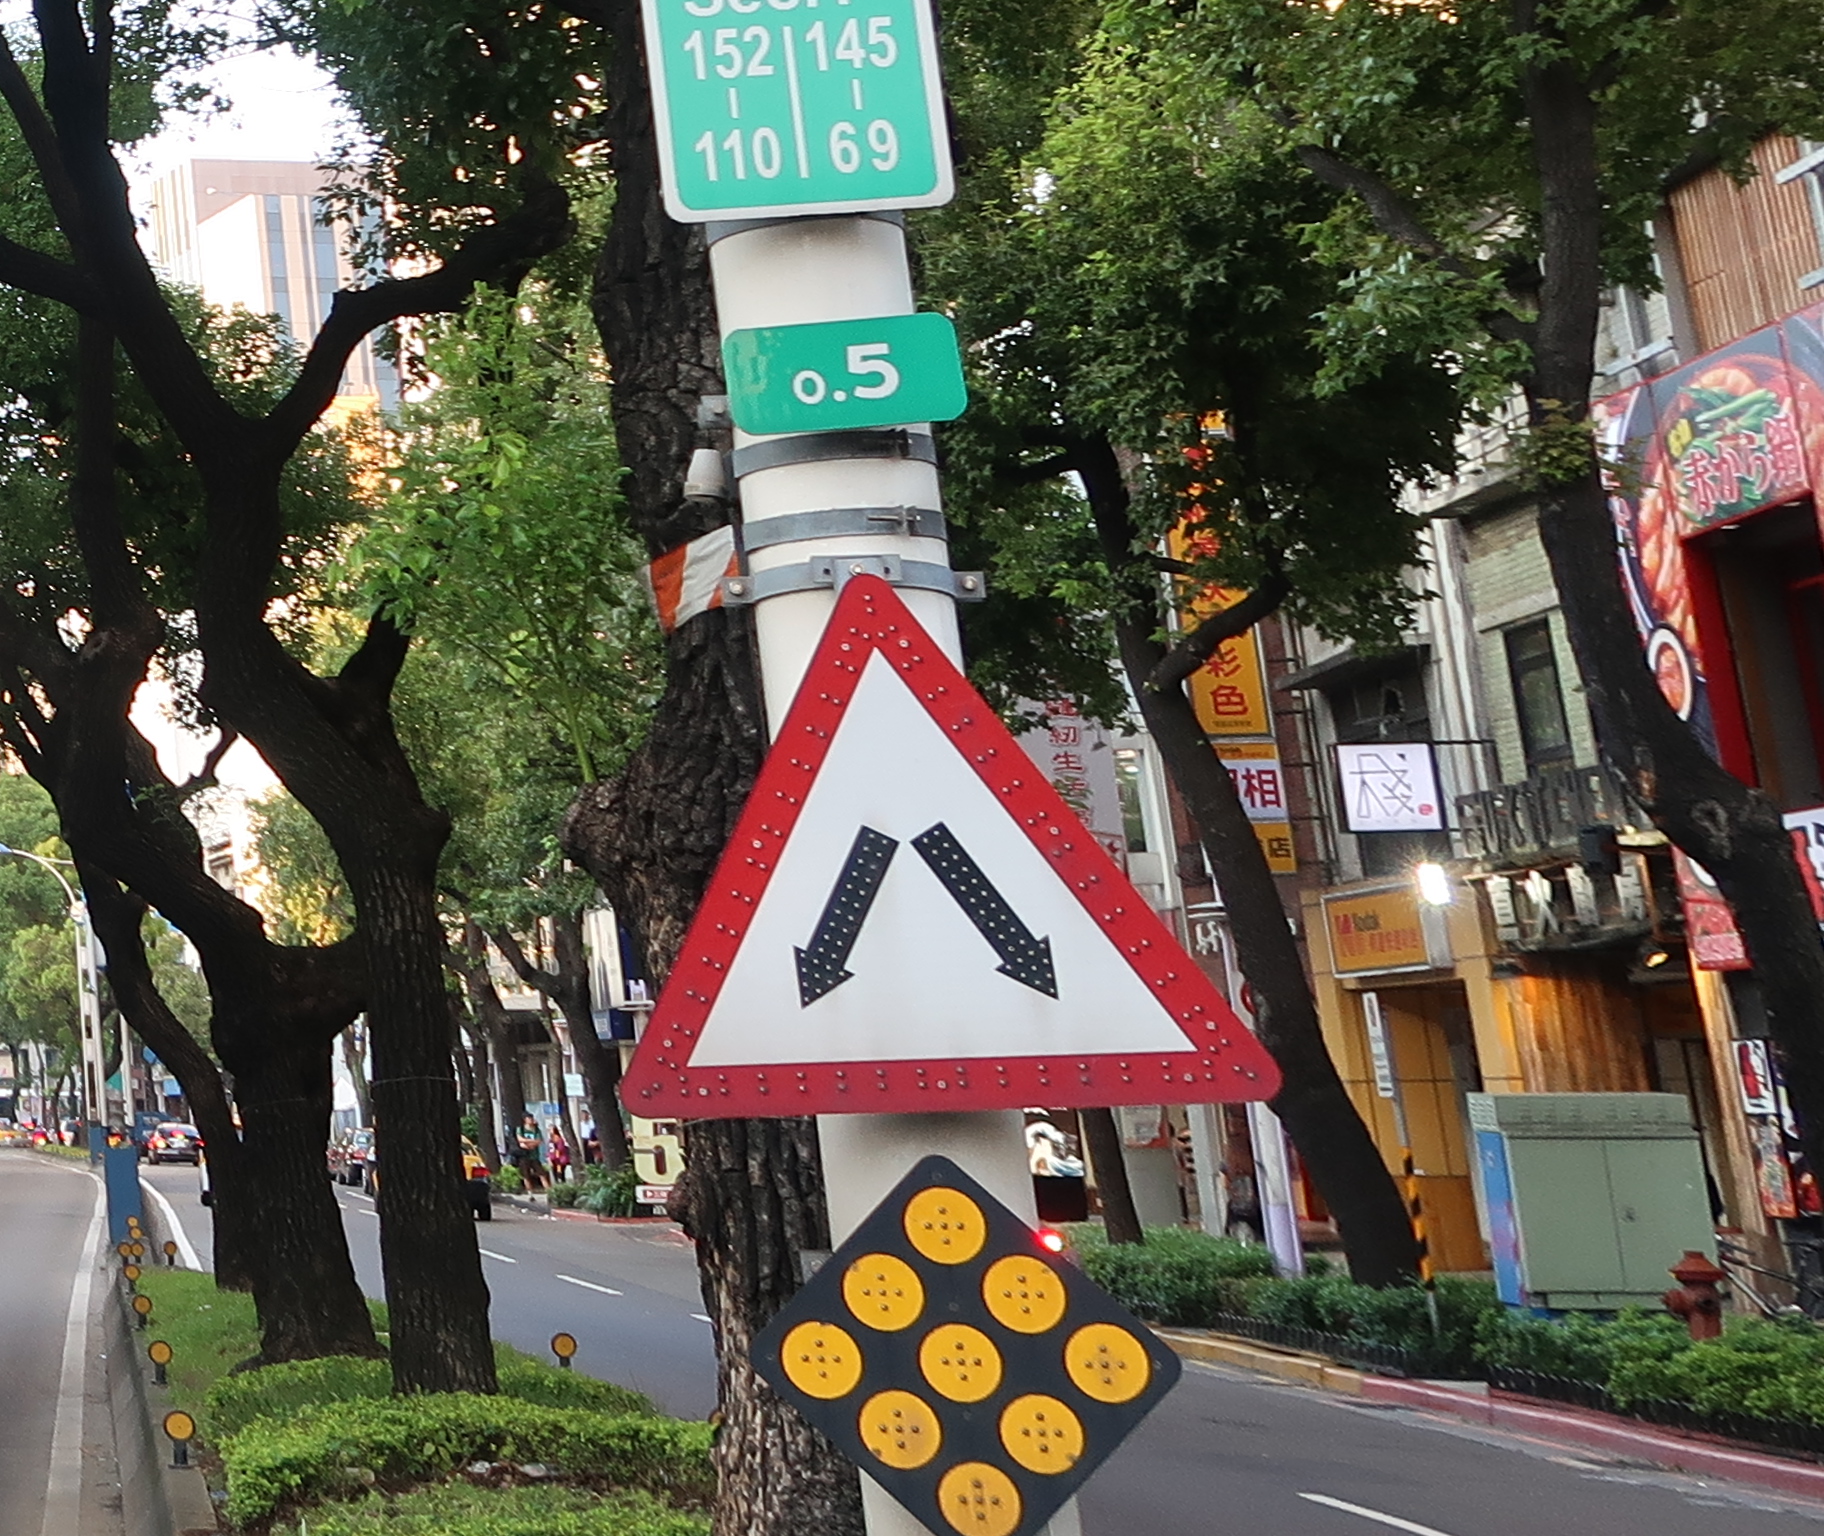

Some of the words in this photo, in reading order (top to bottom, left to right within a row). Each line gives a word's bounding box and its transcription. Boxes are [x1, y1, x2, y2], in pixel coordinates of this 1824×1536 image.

[682, 25, 774, 81] 152
[805, 16, 898, 71] 145
[694, 126, 783, 182] 110
[828, 118, 900, 173] 69
